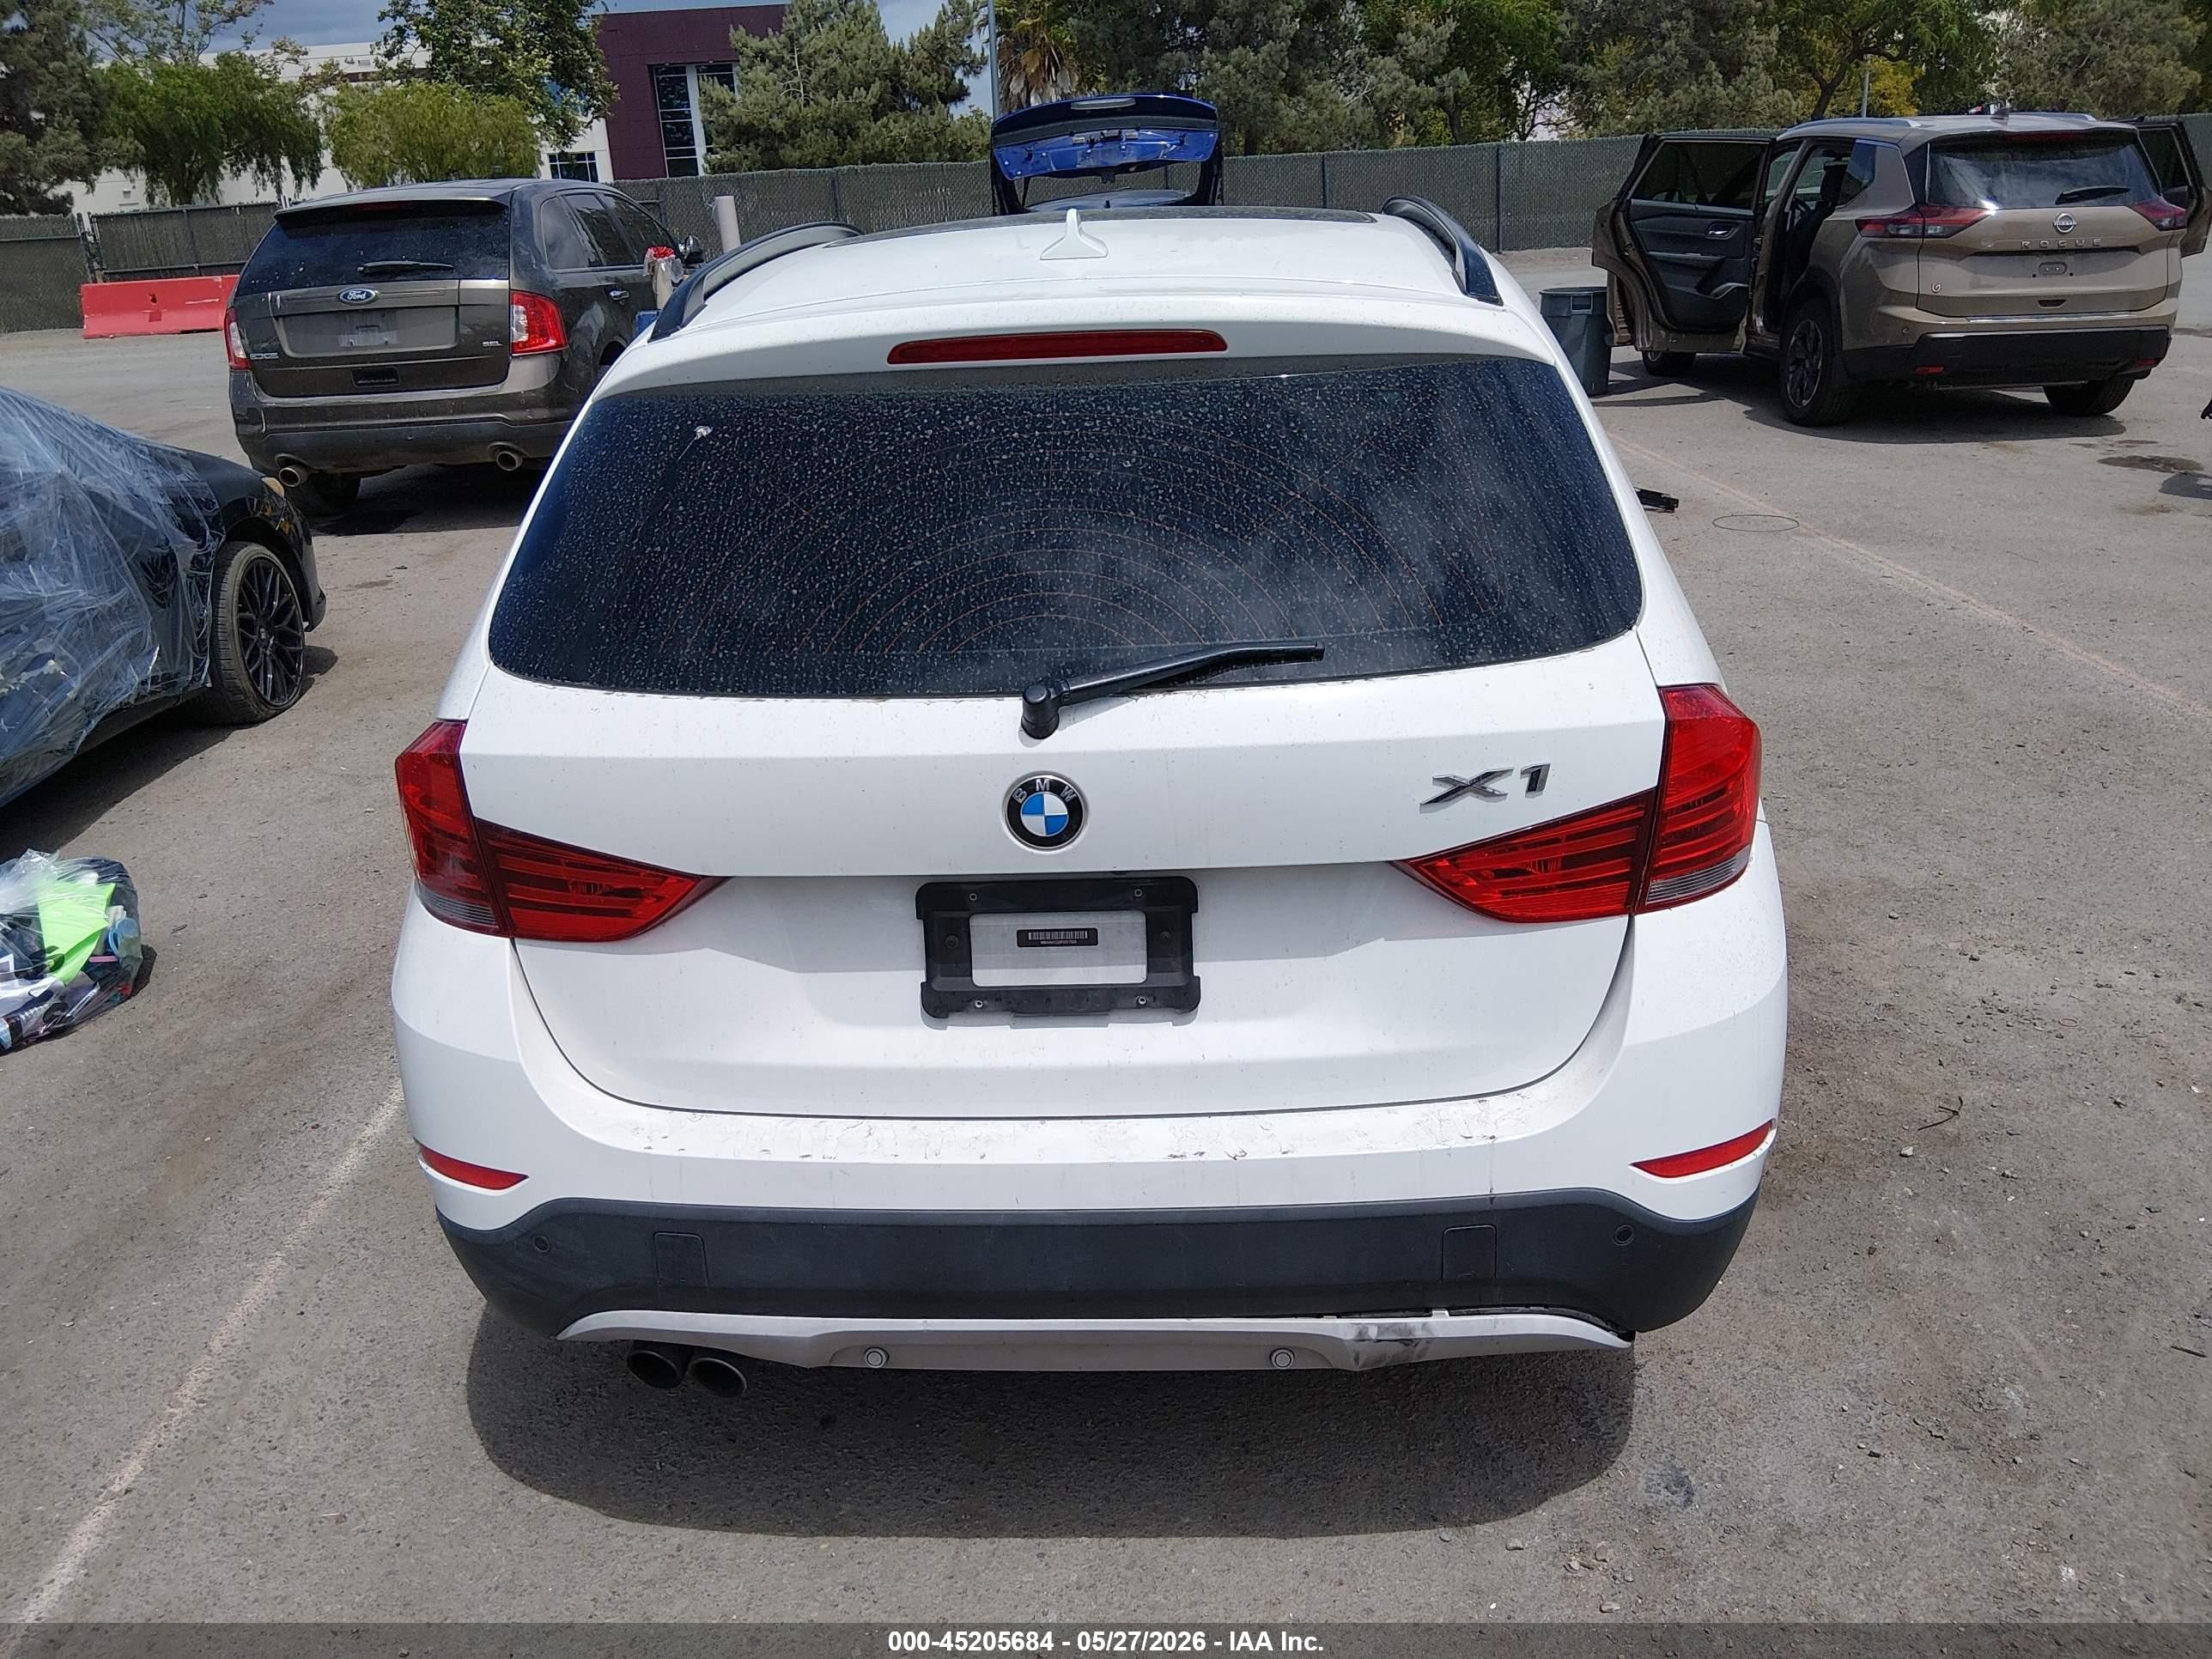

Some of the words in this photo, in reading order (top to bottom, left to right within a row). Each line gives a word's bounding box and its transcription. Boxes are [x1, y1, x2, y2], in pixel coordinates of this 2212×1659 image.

[2021, 239, 2102, 248] ROGUE
[347, 290, 368, 300] Ford
[1012, 778, 1077, 804] BMW
[1419, 763, 1552, 813] X1
